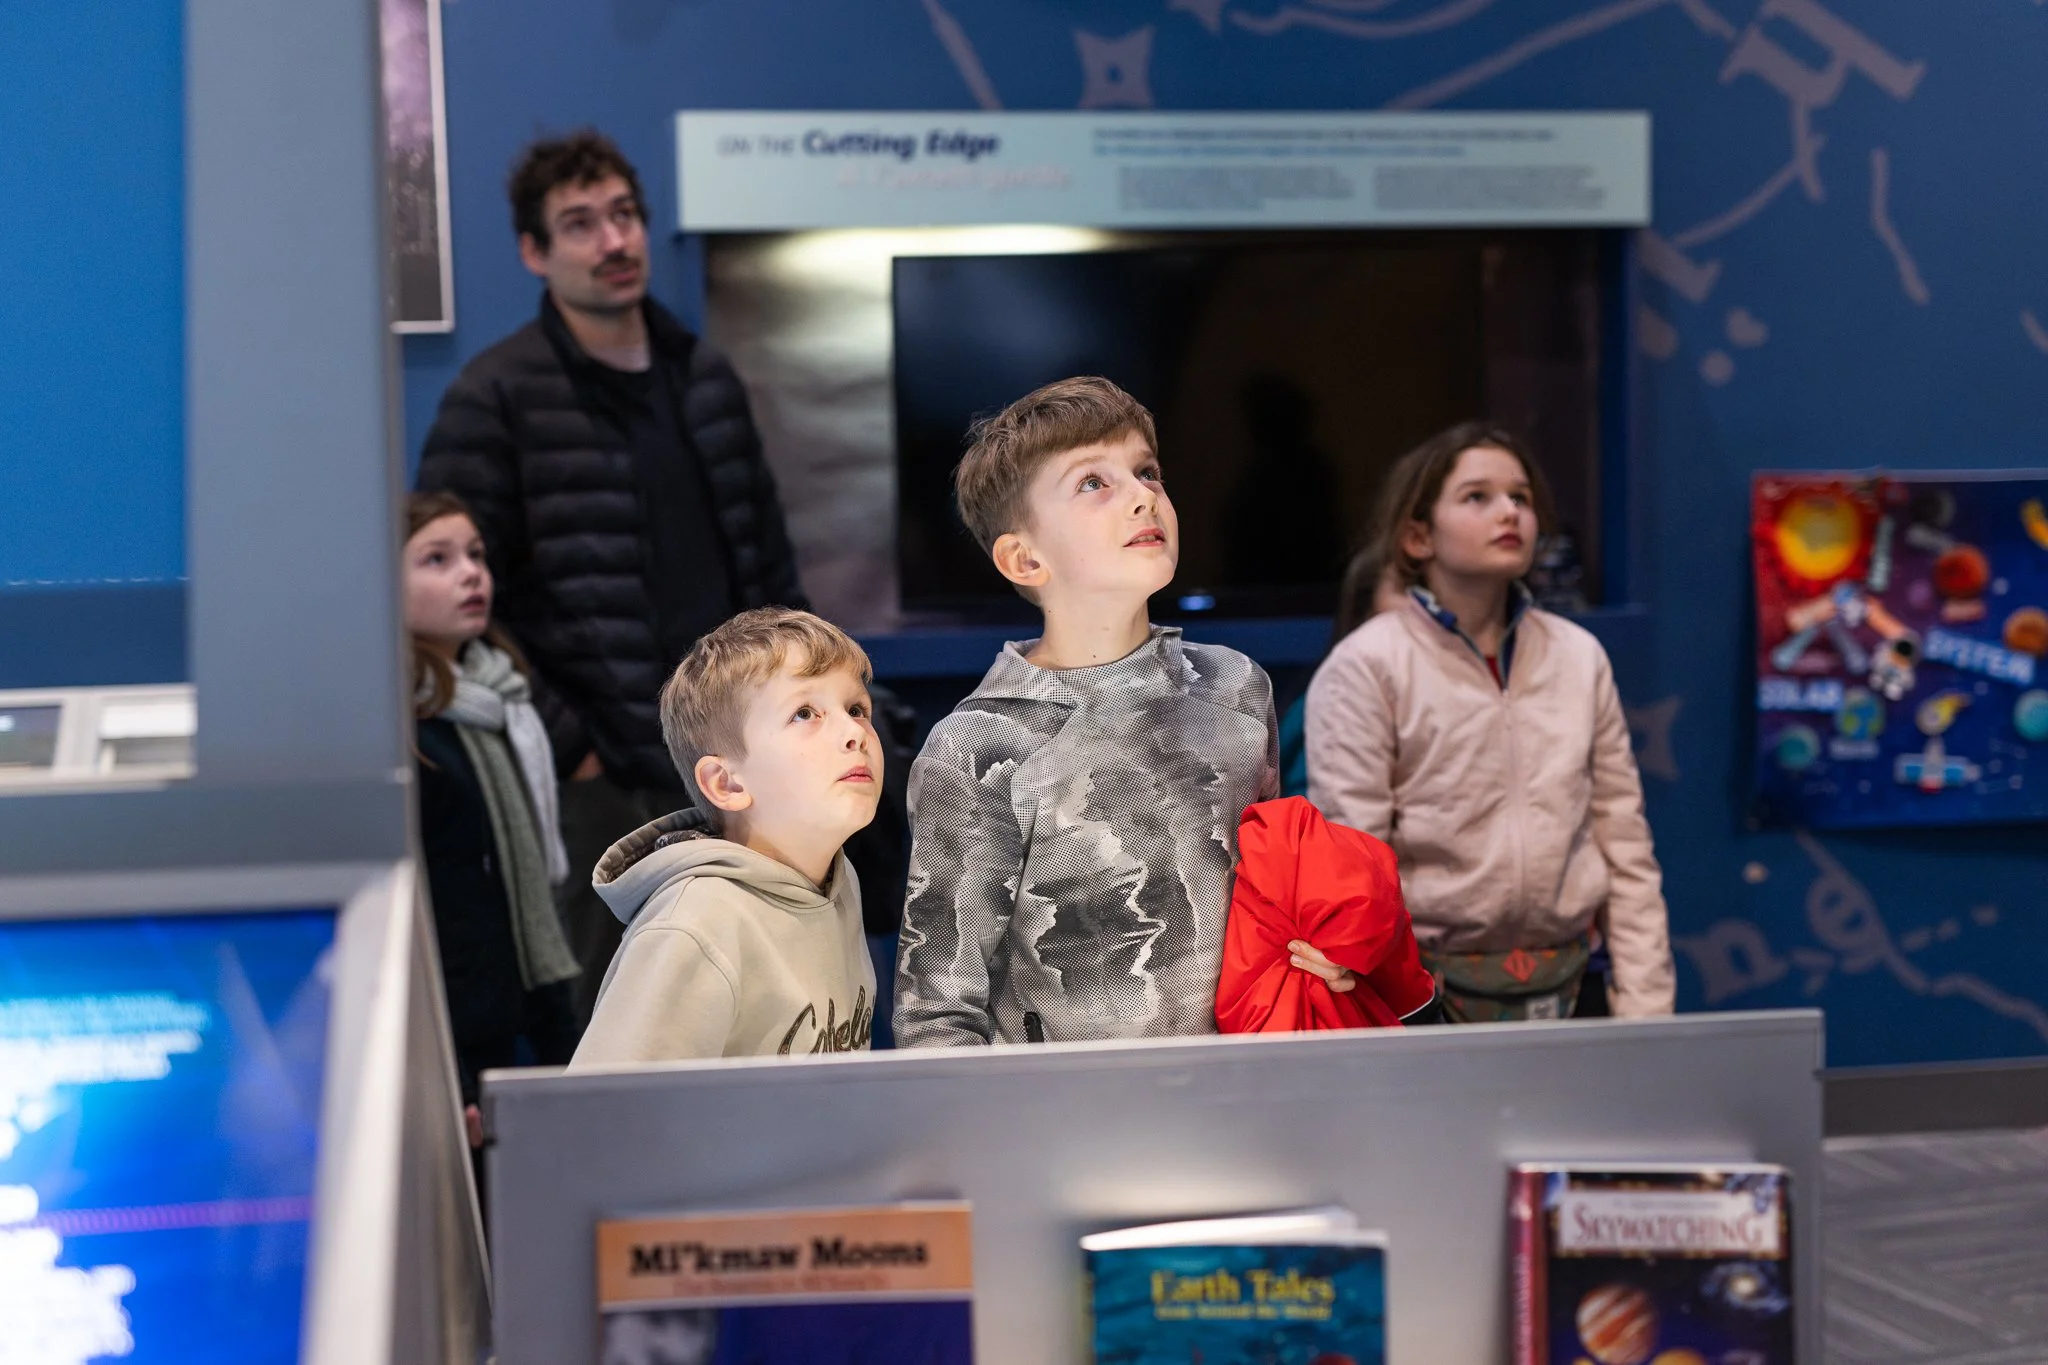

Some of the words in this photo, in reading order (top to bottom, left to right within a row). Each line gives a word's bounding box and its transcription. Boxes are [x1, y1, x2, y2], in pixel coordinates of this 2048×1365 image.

[802, 128, 917, 162] Cutting
[924, 128, 1001, 162] Edge
[777, 984, 876, 1055] Cabela
[1573, 1202, 1765, 1246] SKYWATCHING
[810, 1236, 929, 1269] Moons
[1151, 1268, 1241, 1304] Earth
[1245, 1267, 1336, 1304] Tales
